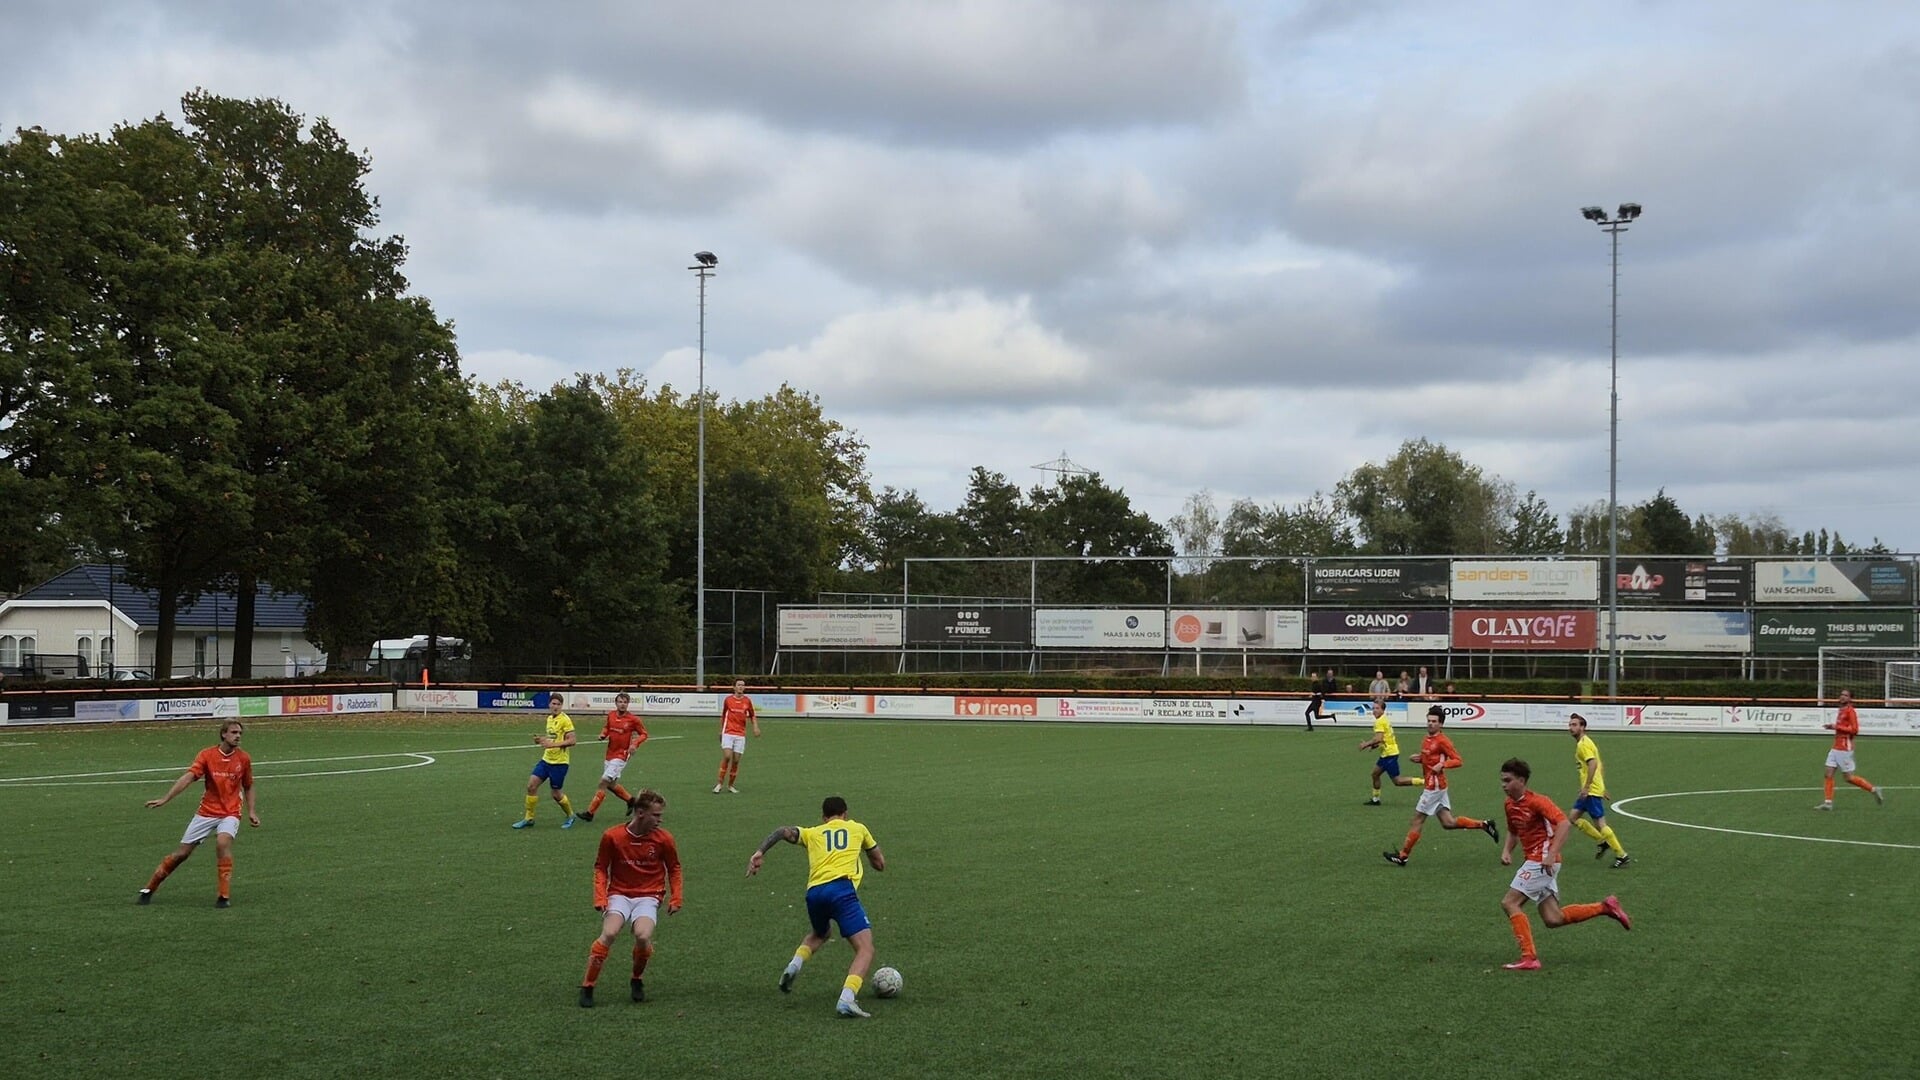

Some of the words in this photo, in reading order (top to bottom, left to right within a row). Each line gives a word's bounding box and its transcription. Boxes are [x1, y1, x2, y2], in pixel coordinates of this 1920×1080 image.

[1315, 568, 1373, 578] NOBRACARS
[1374, 568, 1400, 578] UDEN
[1457, 567, 1529, 581] sanders
[1763, 586, 1783, 594] VAN
[1784, 586, 1835, 594] SCHIJNDEL
[1345, 614, 1408, 627] GRANDO
[955, 626, 991, 634] PUMPKE
[1760, 624, 1816, 636] Bernheze
[1827, 624, 1855, 632] THUIS
[1856, 624, 1866, 632] IN
[1868, 624, 1904, 632] WONEN
[1104, 631, 1123, 639] MAAS
[1124, 631, 1129, 639] &
[1130, 631, 1145, 639] VAN
[1146, 631, 1161, 639] OSS
[170, 699, 207, 708] MOSTAKO
[299, 695, 328, 706] KLING
[347, 698, 378, 709] Rabobank
[492, 699, 508, 707] GEEN
[508, 699, 535, 708] ALCOHOL
[645, 695, 681, 705] Vikamco
[1153, 700, 1177, 708] STEUN
[1180, 700, 1190, 708] DE
[983, 699, 1033, 716] irene
[1443, 707, 1474, 718] opro
[1144, 709, 1154, 718] UW
[1158, 709, 1193, 718] RECLAME
[1196, 709, 1215, 718] HIER
[1746, 708, 1792, 722] Vitaro
[822, 829, 848, 852] 10
